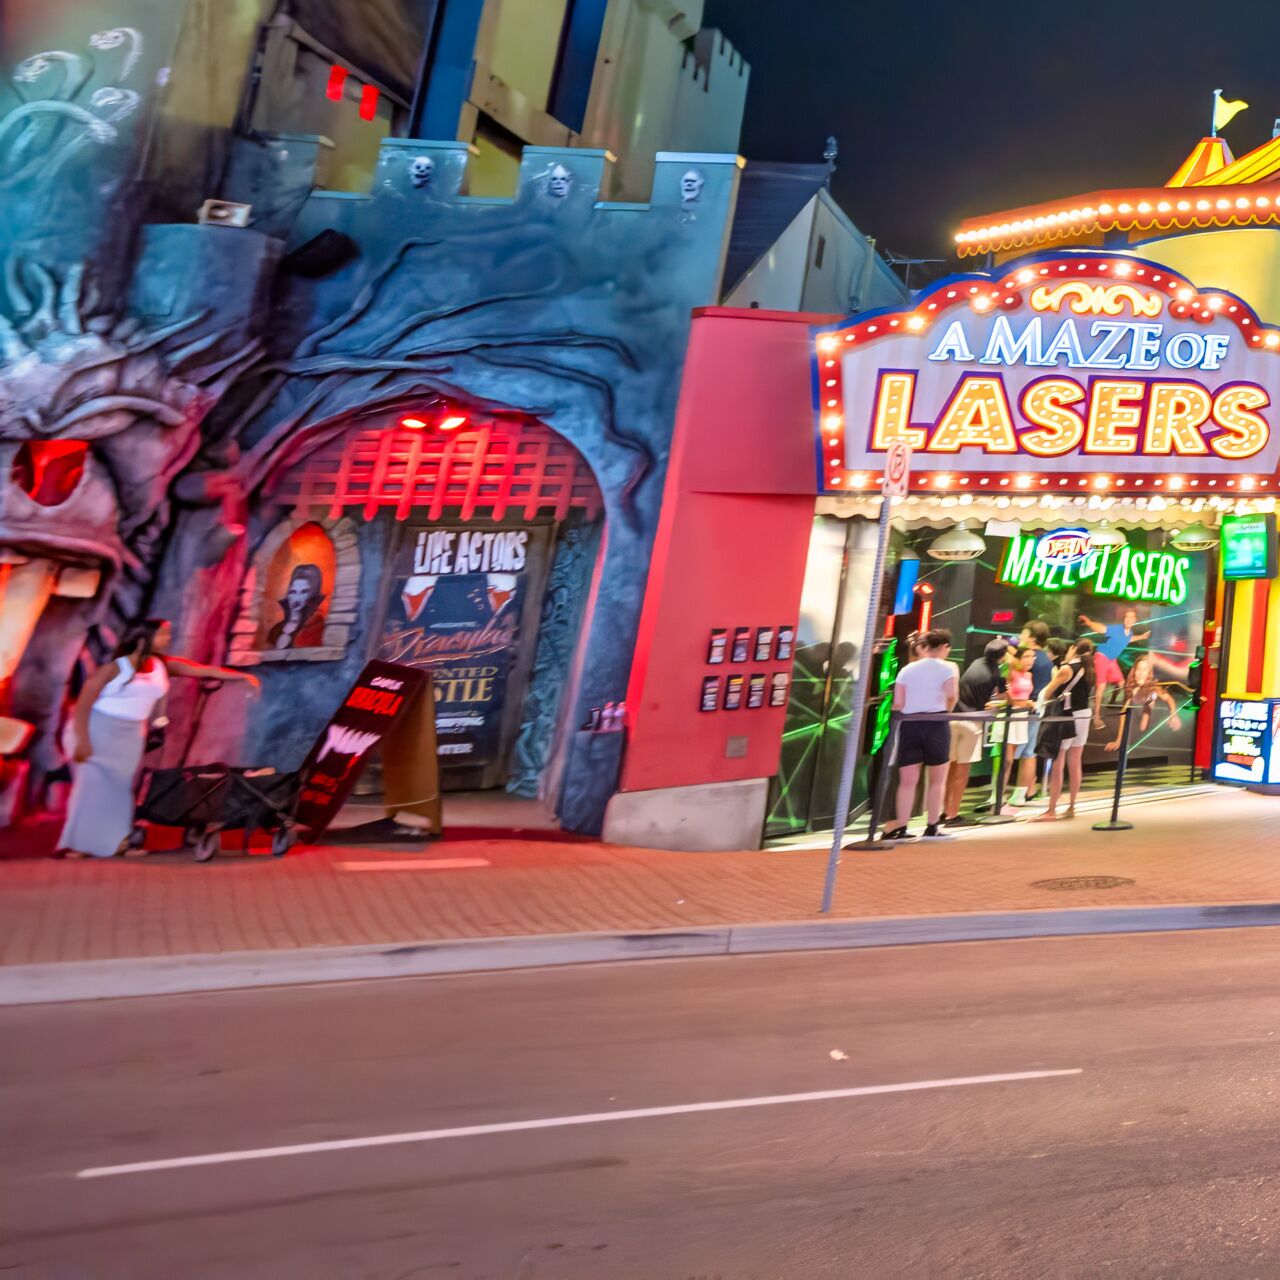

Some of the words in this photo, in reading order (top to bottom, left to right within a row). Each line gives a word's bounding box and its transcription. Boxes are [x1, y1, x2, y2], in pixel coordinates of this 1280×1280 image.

[928, 320, 973, 363] A
[979, 316, 1161, 371] MAZE
[1164, 329, 1231, 371] OF
[868, 368, 1272, 459] LASERS
[414, 530, 456, 574] LIVE
[454, 530, 528, 575] ACTORS
[1095, 545, 1190, 605] LASERS
